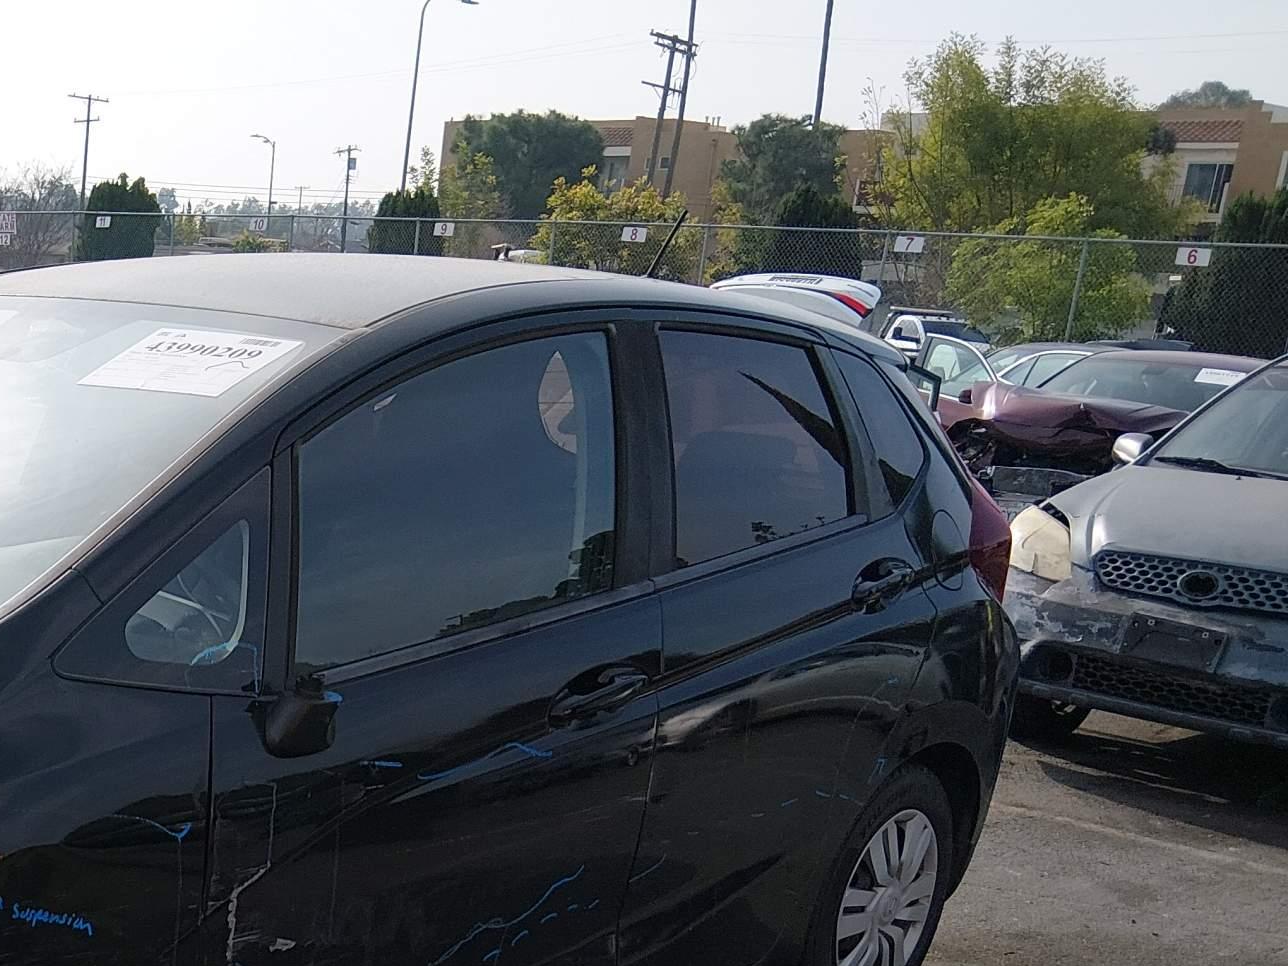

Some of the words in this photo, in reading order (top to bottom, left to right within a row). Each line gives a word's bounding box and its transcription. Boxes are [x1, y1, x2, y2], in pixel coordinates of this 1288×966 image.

[254, 218, 264, 230] 10
[440, 223, 448, 235] 9
[0, 235, 9, 244] 12
[630, 228, 638, 241] 8
[905, 237, 915, 251] 7
[1187, 249, 1198, 265] 6
[144, 340, 264, 361] 43990209
